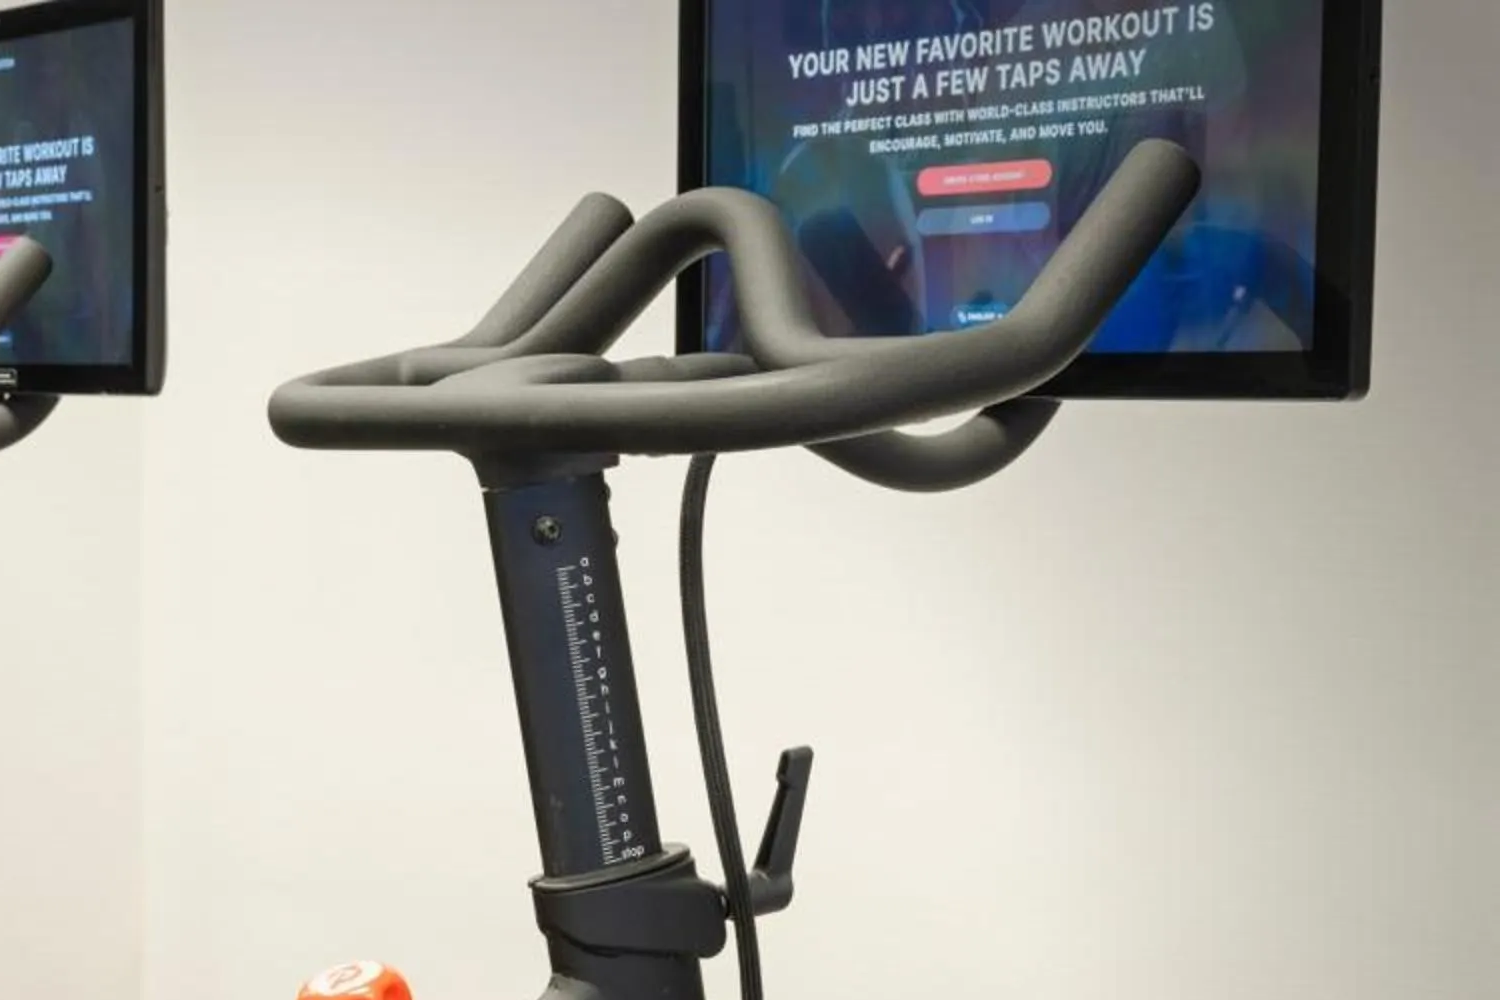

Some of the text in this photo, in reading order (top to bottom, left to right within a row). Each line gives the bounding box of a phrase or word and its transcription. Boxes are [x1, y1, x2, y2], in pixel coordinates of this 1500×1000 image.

[788, 2, 1214, 80] YOUR NEW FAVORITE WORKOUT IS
[846, 48, 1146, 107] JUST A FEW TAPS AWAY
[793, 85, 1205, 138] FIND THE PERFECT CLASS WITH WORLD-CLASS INSTRUCTORS THAT'LL
[22, 137, 79, 162] WORKOUT
[81, 135, 94, 156] IS
[869, 119, 1109, 154] ENCOURAGE, MOTIVATE, AND MOVE YOU.
[5, 168, 32, 189] TAPS
[34, 164, 68, 185] AWAY
